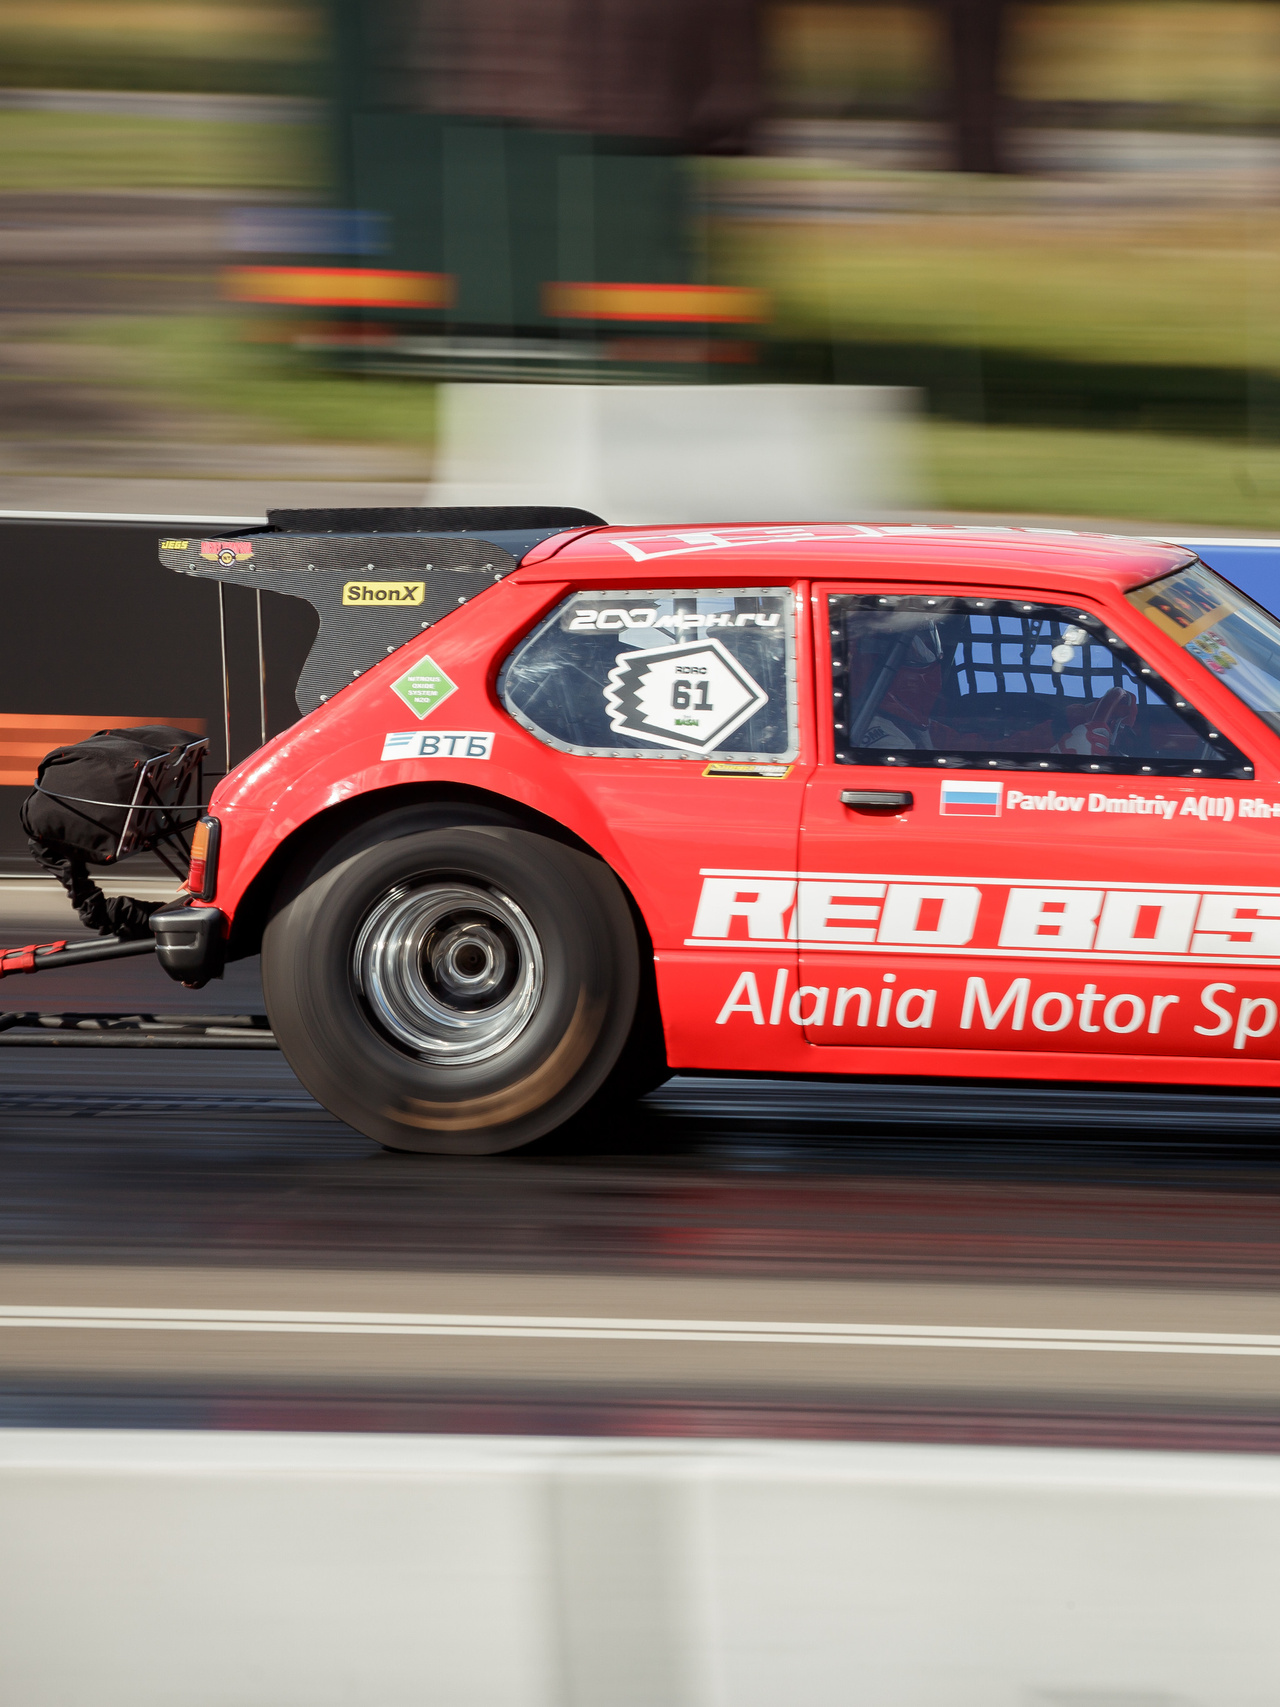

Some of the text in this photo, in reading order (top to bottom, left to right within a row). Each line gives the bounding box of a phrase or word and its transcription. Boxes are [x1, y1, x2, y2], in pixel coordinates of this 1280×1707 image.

[161, 541, 188, 549] JEGS
[347, 586, 419, 601] ShonX
[672, 679, 713, 711] 61
[418, 735, 488, 757] ВТБ
[1006, 790, 1085, 812] Pavlov
[1088, 793, 1178, 820] Dmitriy
[1179, 796, 1235, 821] A(II)
[691, 877, 983, 946] RED
[715, 968, 938, 1029] Alania
[959, 976, 1179, 1036] Motor
